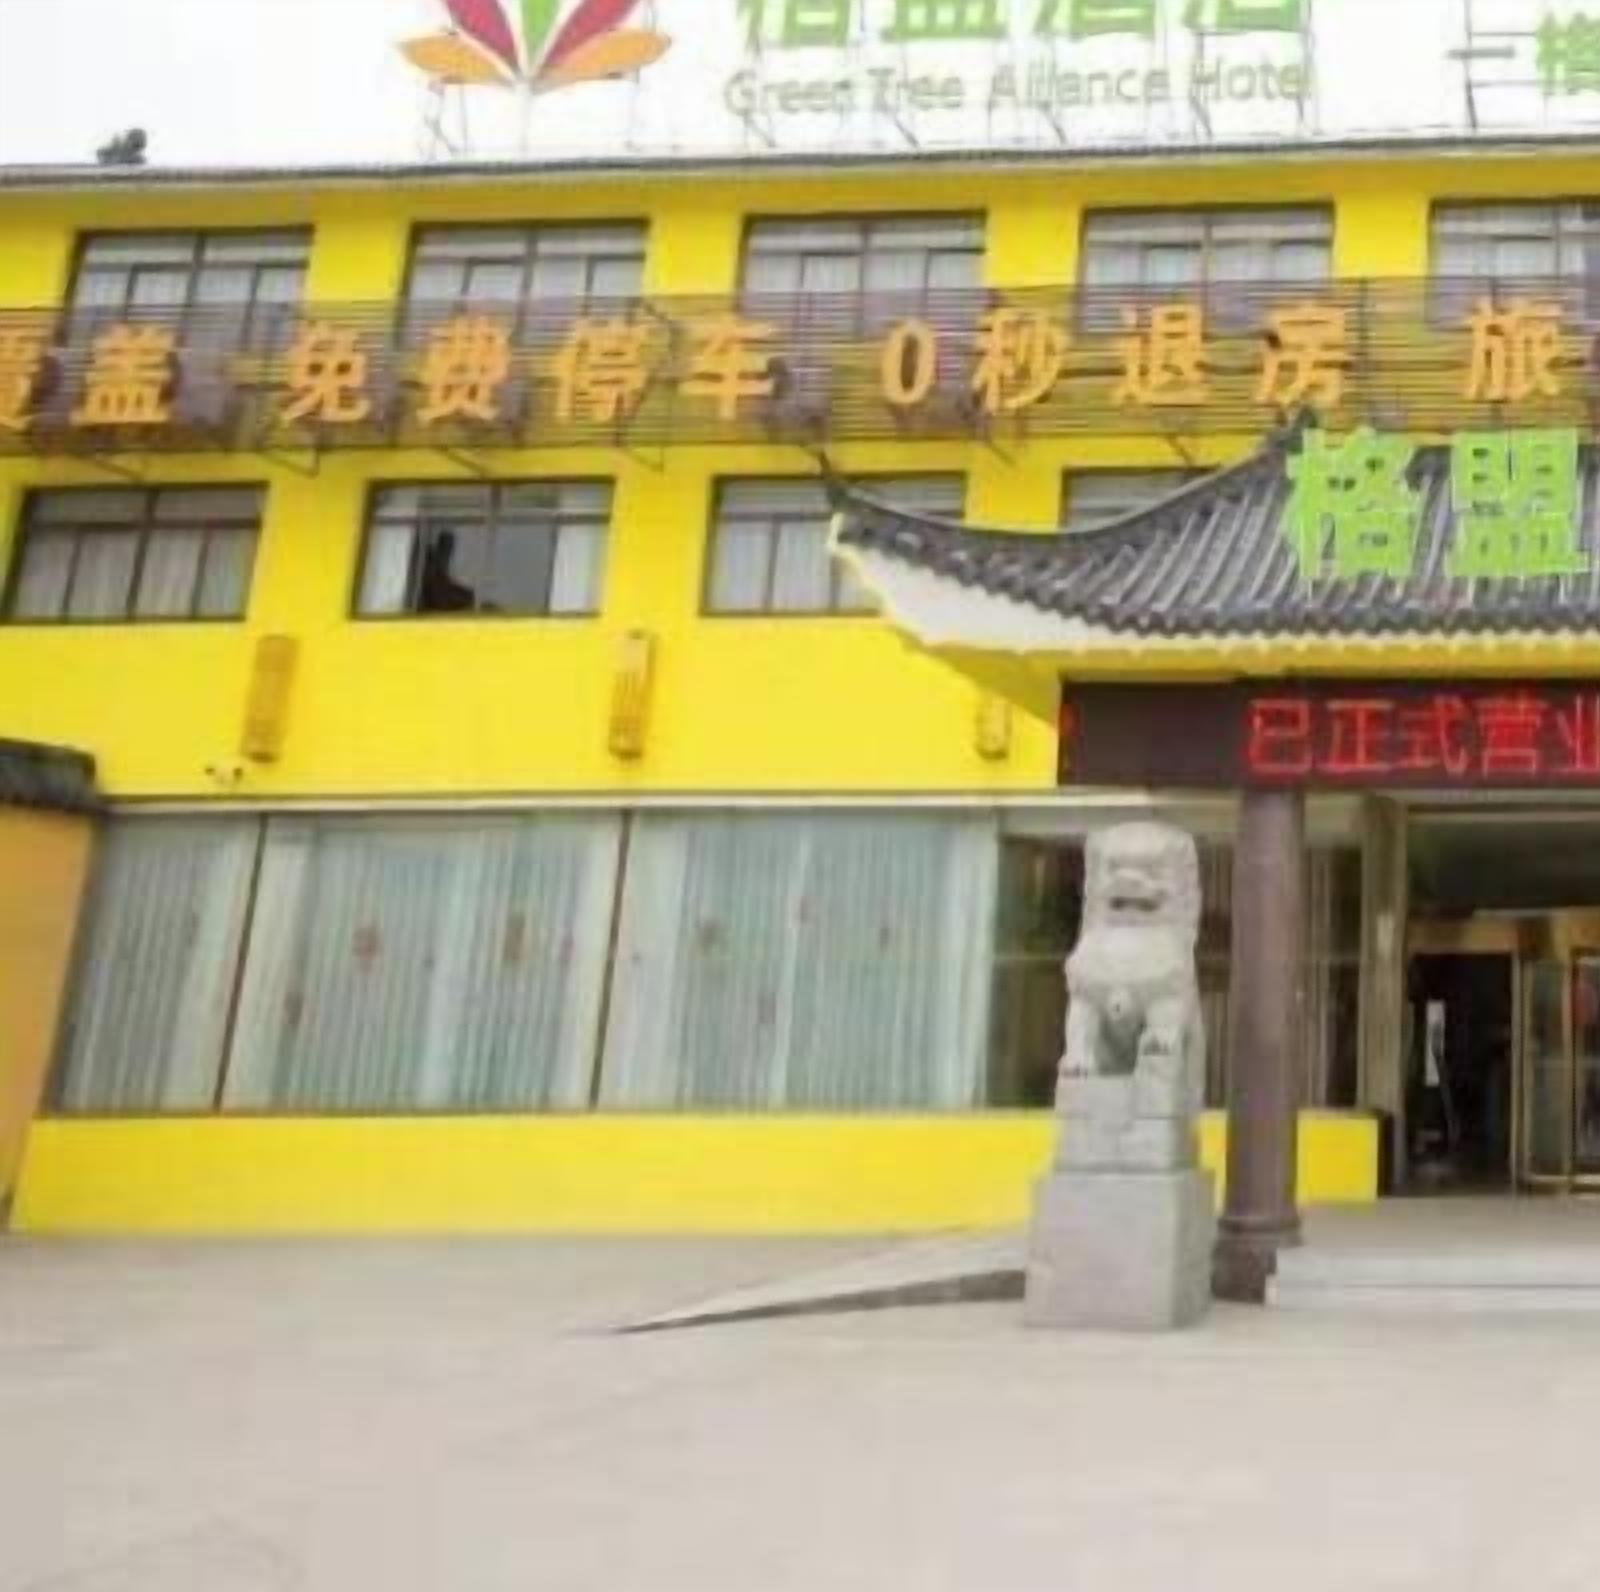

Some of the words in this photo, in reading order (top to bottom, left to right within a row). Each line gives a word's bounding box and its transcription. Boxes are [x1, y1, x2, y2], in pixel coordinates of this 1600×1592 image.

[724, 67, 853, 116] Green
[866, 66, 964, 109] Tree
[280, 312, 776, 425] 免费停车
[880, 300, 1354, 416] 0秒退房
